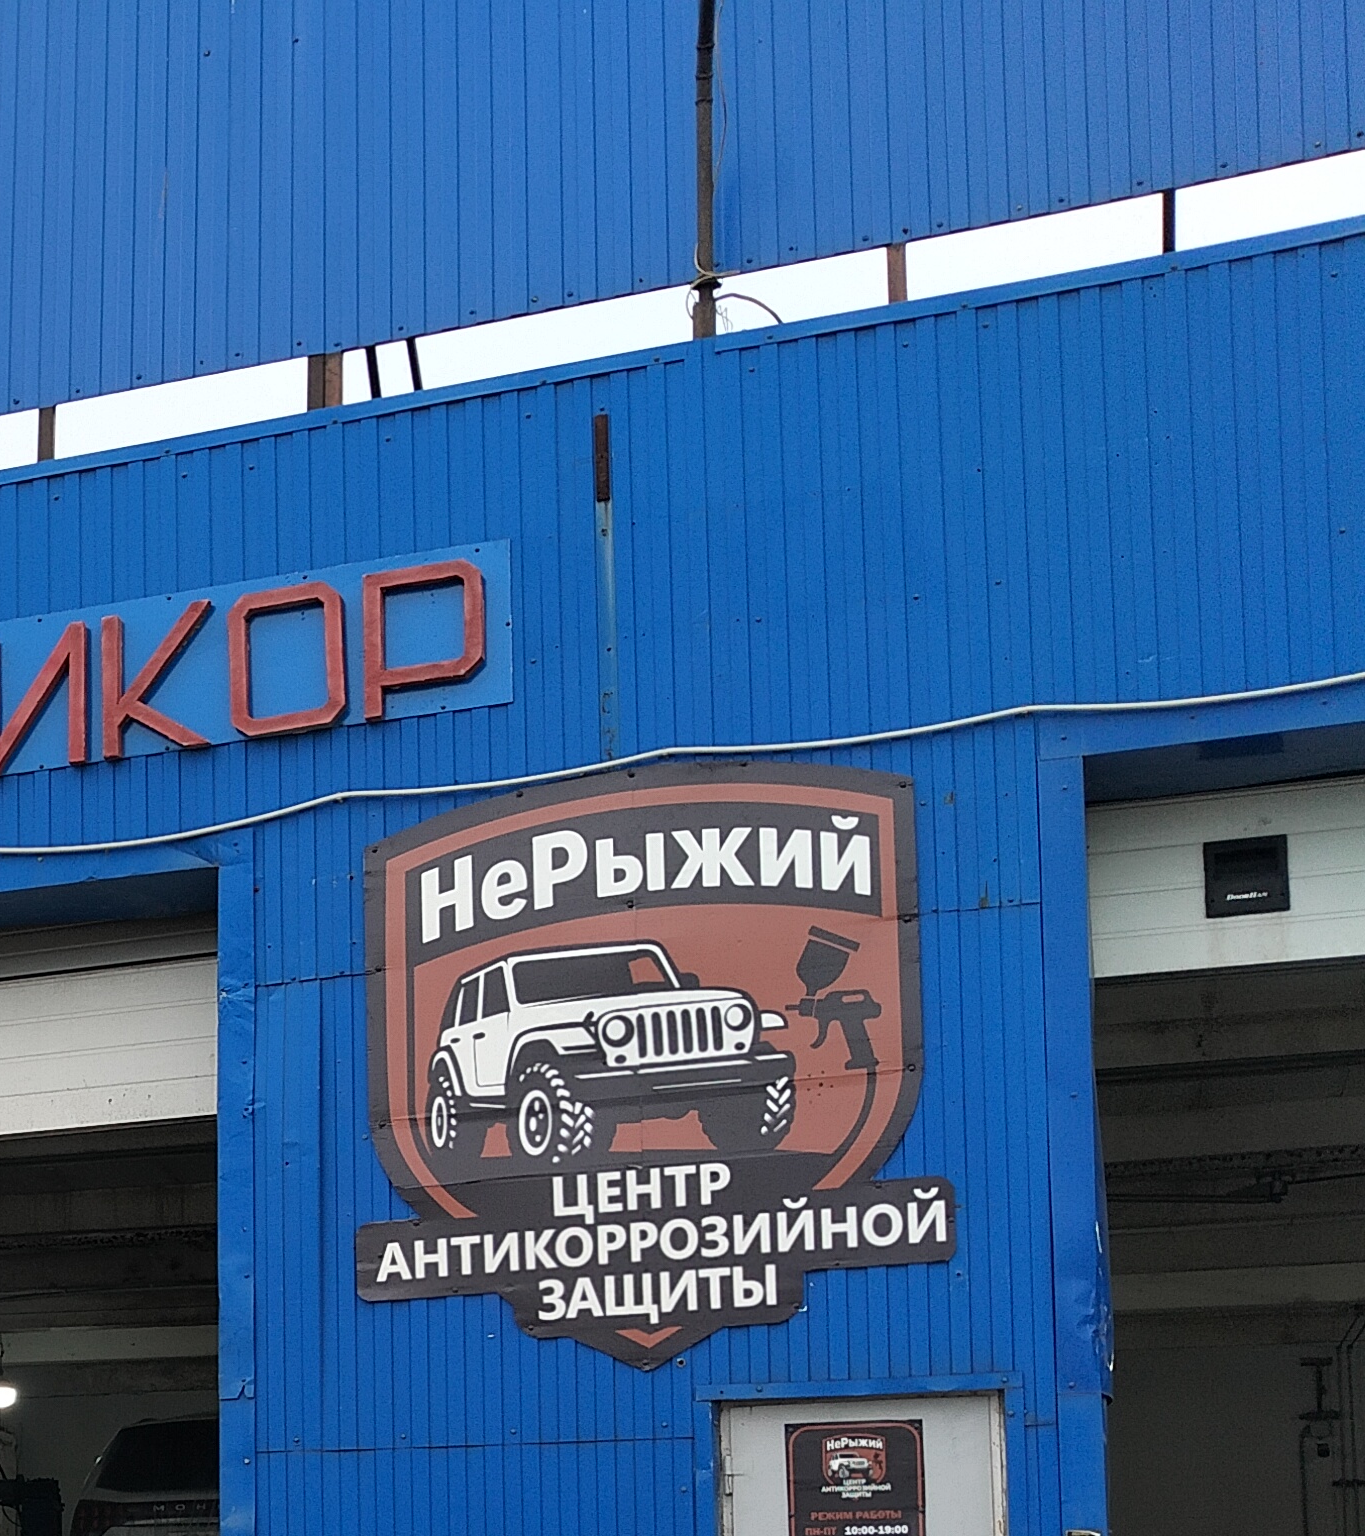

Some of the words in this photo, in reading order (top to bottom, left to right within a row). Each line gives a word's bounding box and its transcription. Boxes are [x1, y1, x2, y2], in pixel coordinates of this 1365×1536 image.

[419, 815, 872, 945] НеРыжий
[551, 1162, 731, 1225] ЦЕНТР
[375, 1186, 948, 1283] АНТИКОРРОЗИЙНОЙ
[537, 1263, 778, 1325] ЗАЩИТЫ
[826, 1437, 883, 1451] НеРыжий
[805, 1527, 837, 1536] ПН-ПТ
[844, 1525, 909, 1536] 10:00-19:00
[810, 1511, 853, 1521] РЕЖИМ
[855, 1510, 902, 1519] РАБОТЫ
